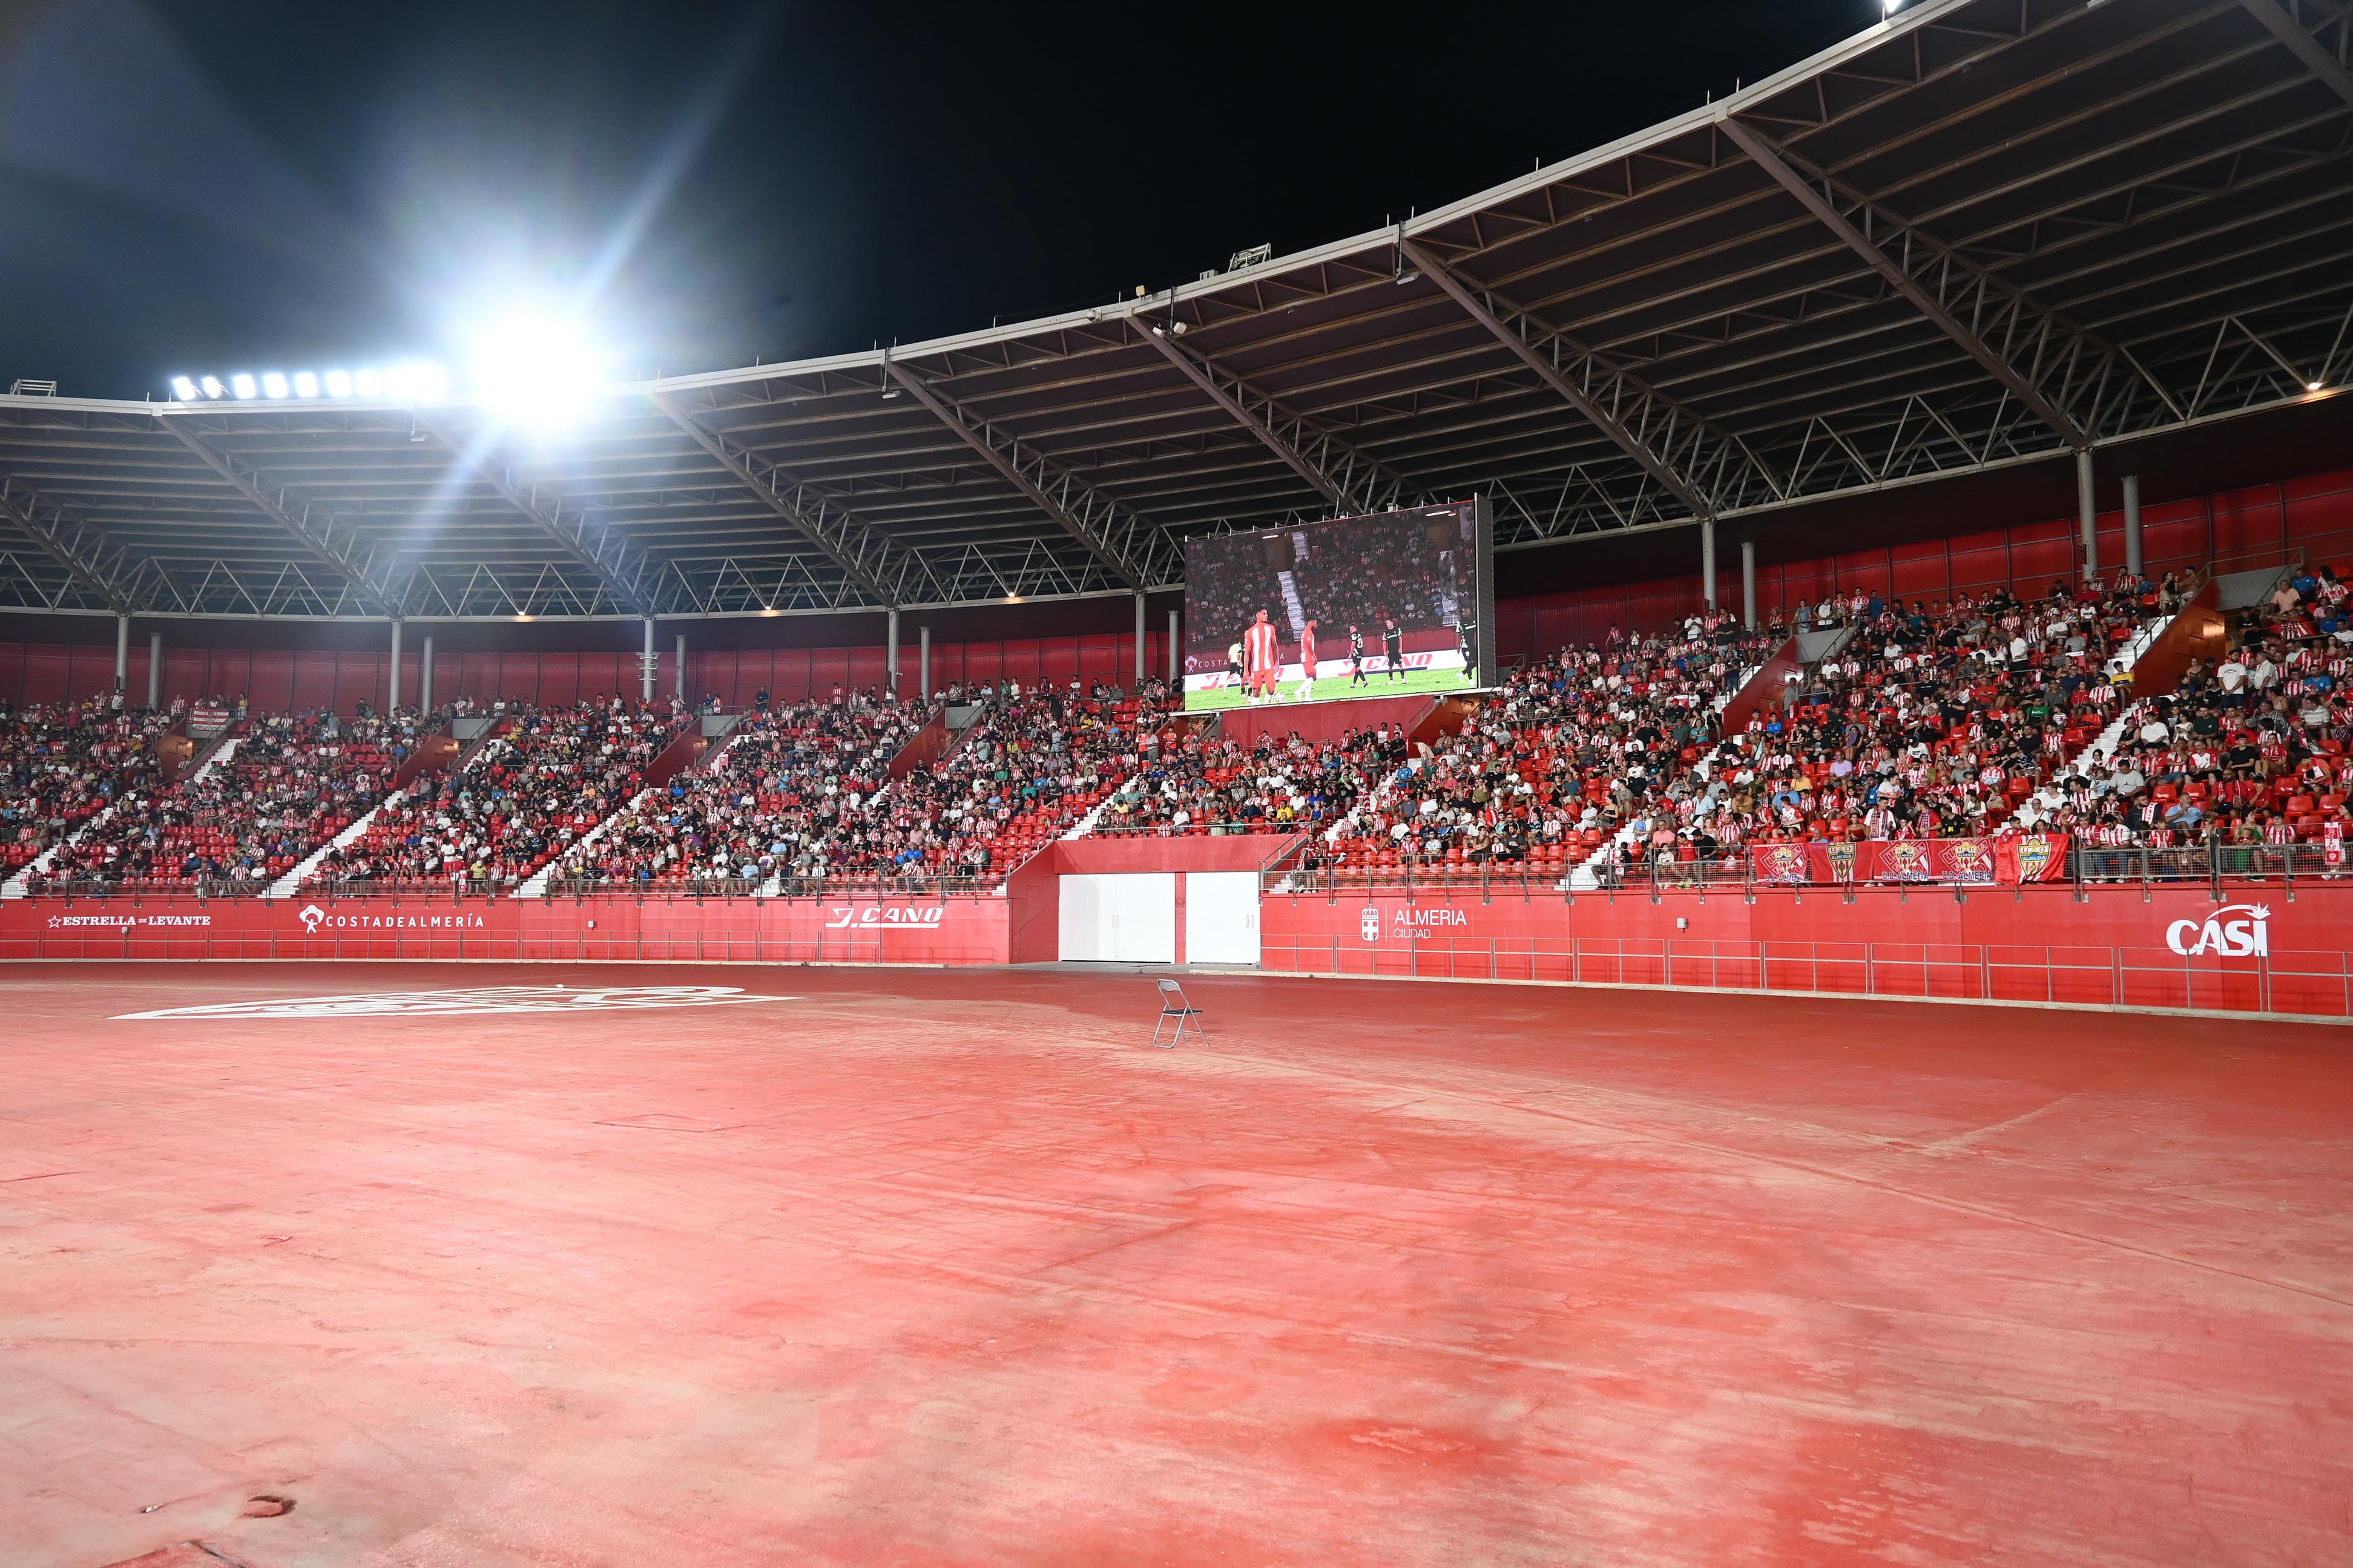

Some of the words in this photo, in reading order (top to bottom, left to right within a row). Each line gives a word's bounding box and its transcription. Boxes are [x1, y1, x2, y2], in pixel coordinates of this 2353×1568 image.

[1958, 871, 1992, 881] ALMERIA
[62, 916, 136, 926] ESTRELLA
[148, 916, 211, 925] LEVANTE
[1394, 910, 1467, 926] ALMERIA
[1394, 928, 1431, 939] CIUDAD
[2166, 919, 2268, 957] CASI
